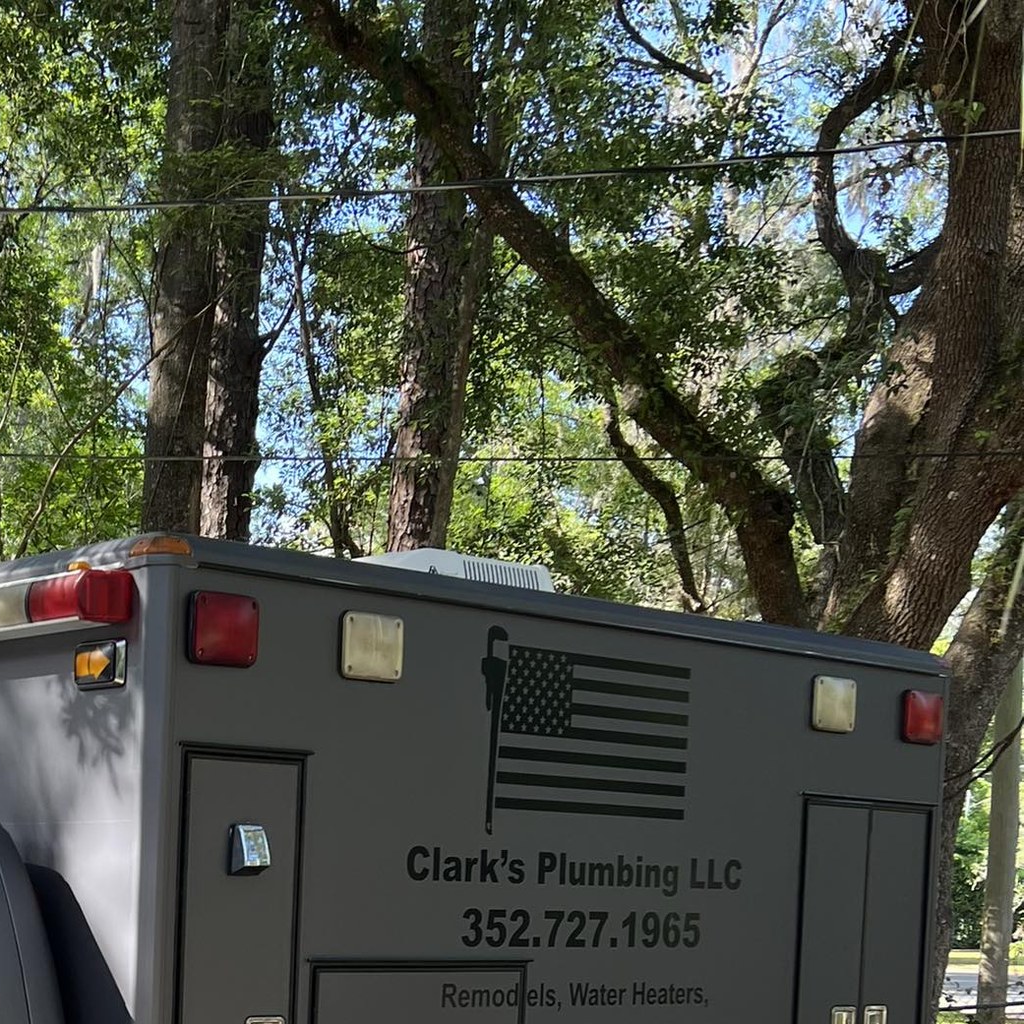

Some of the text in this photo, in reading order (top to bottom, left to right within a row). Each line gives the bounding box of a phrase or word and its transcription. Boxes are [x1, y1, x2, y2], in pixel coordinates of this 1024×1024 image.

[407, 846, 742, 897] Clark's Plumbing LLC
[461, 907, 701, 948] 352.727.1965
[440, 981, 709, 1011] Remodels, Water Heaters,
